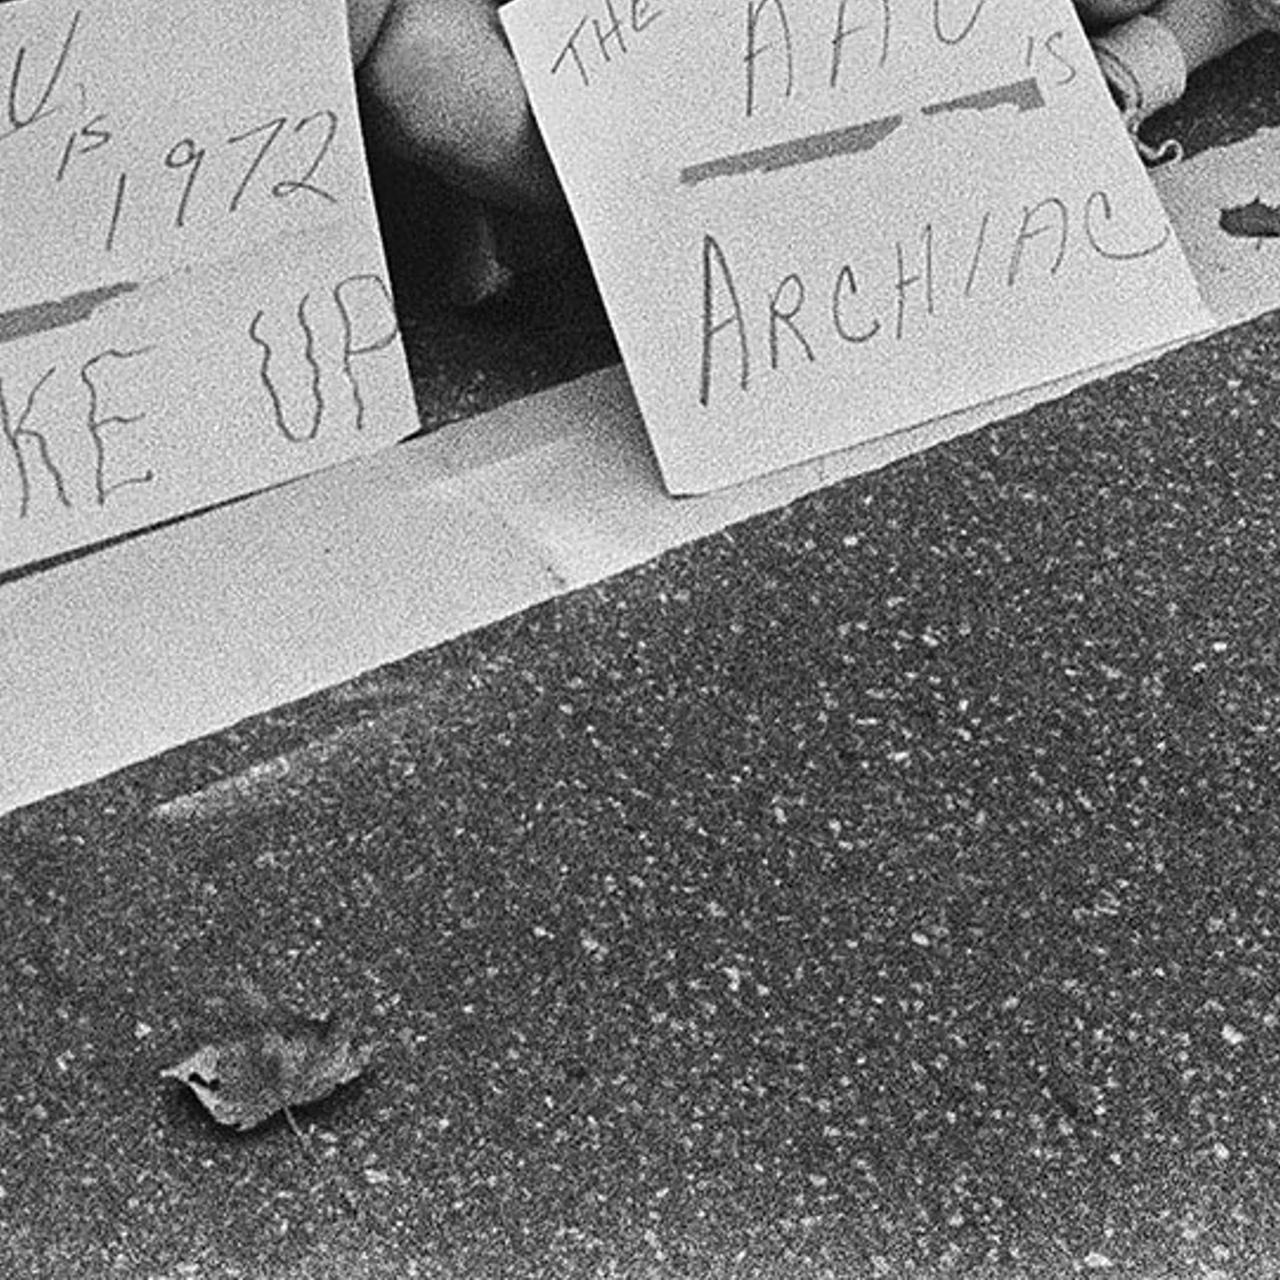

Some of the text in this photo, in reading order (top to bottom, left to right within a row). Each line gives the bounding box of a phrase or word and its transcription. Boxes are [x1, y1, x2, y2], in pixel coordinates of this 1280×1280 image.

[1026, 32, 1076, 86] IS
[58, 114, 112, 182] IS
[106, 110, 338, 252] 1972
[249, 275, 399, 442] UP
[698, 192, 1172, 406] ARCHIAC
